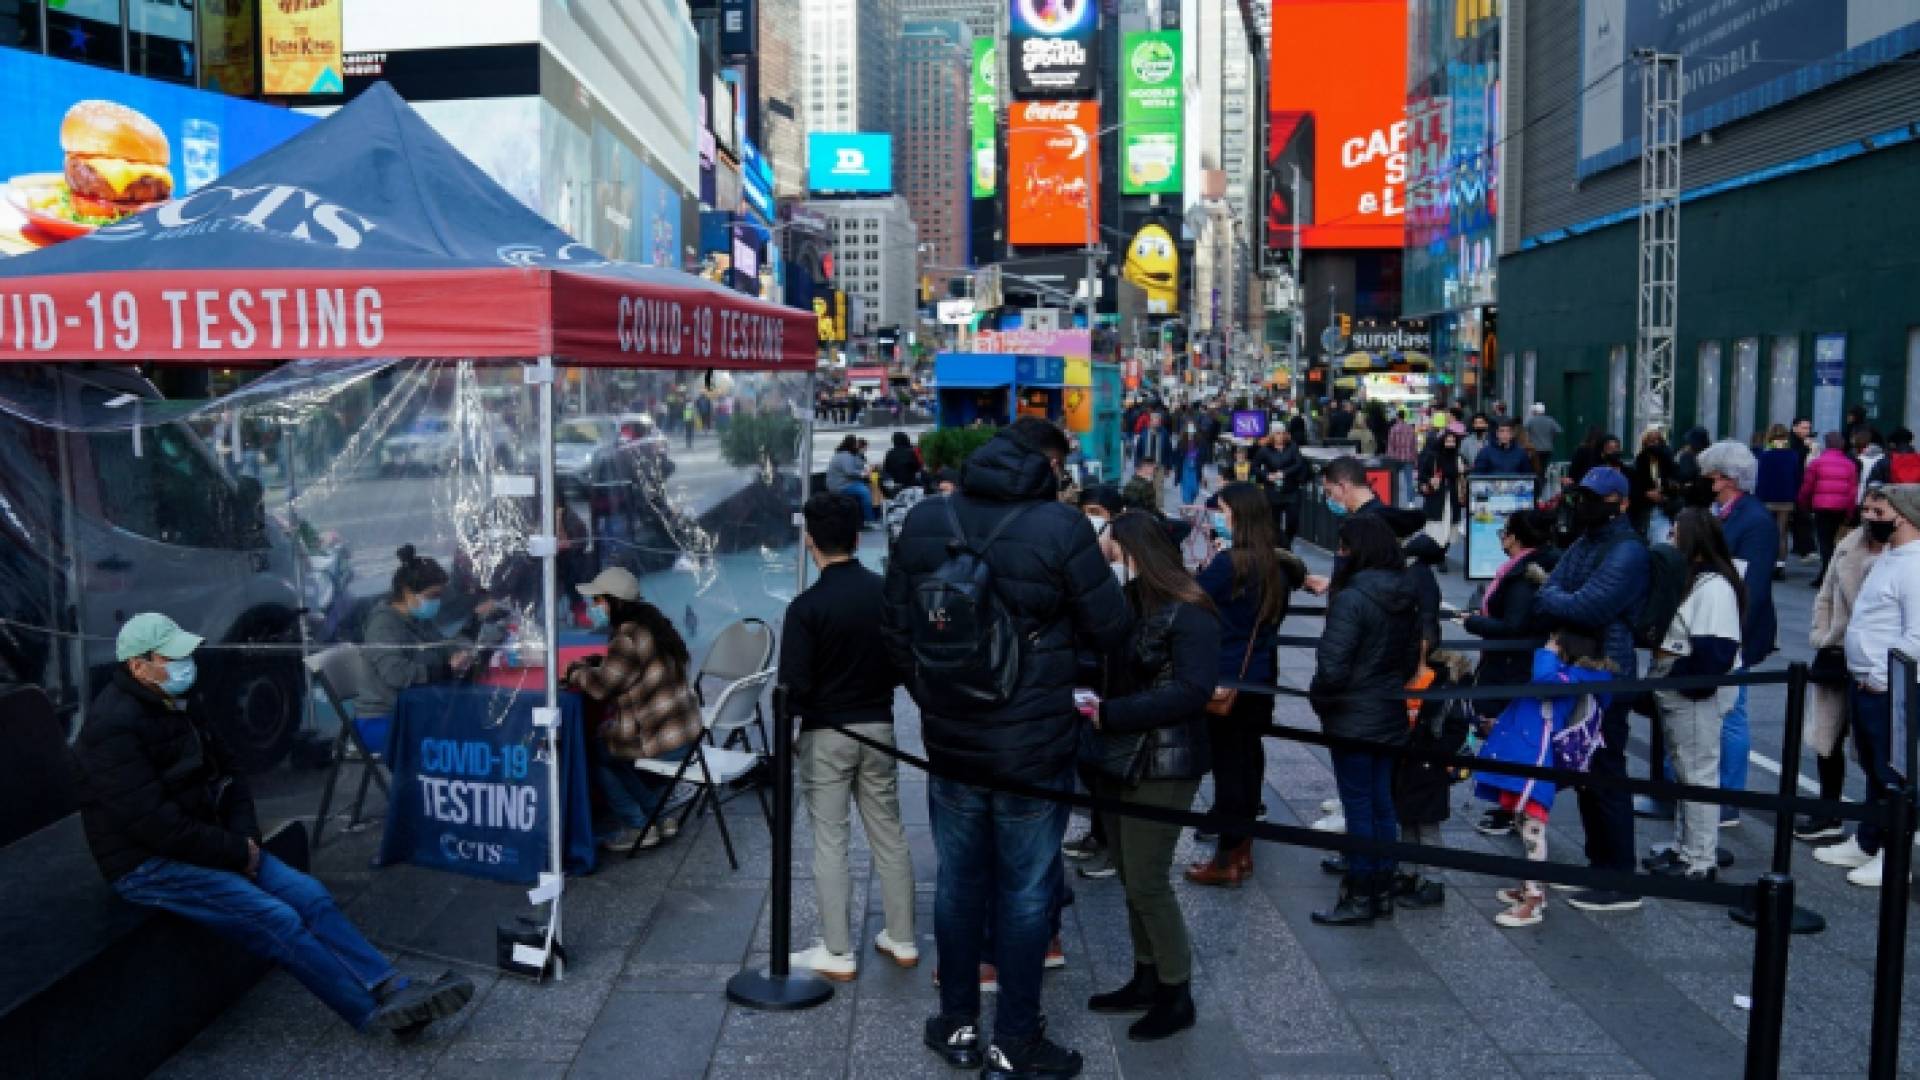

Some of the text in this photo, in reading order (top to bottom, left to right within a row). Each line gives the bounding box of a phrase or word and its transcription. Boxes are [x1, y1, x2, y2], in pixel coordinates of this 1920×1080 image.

[157, 184, 377, 250] CTS
[162, 287, 384, 349] TESTING
[617, 294, 785, 361] COVID-19 TESTING
[420, 738, 528, 779] COVID-19
[416, 773, 537, 832] TESTING
